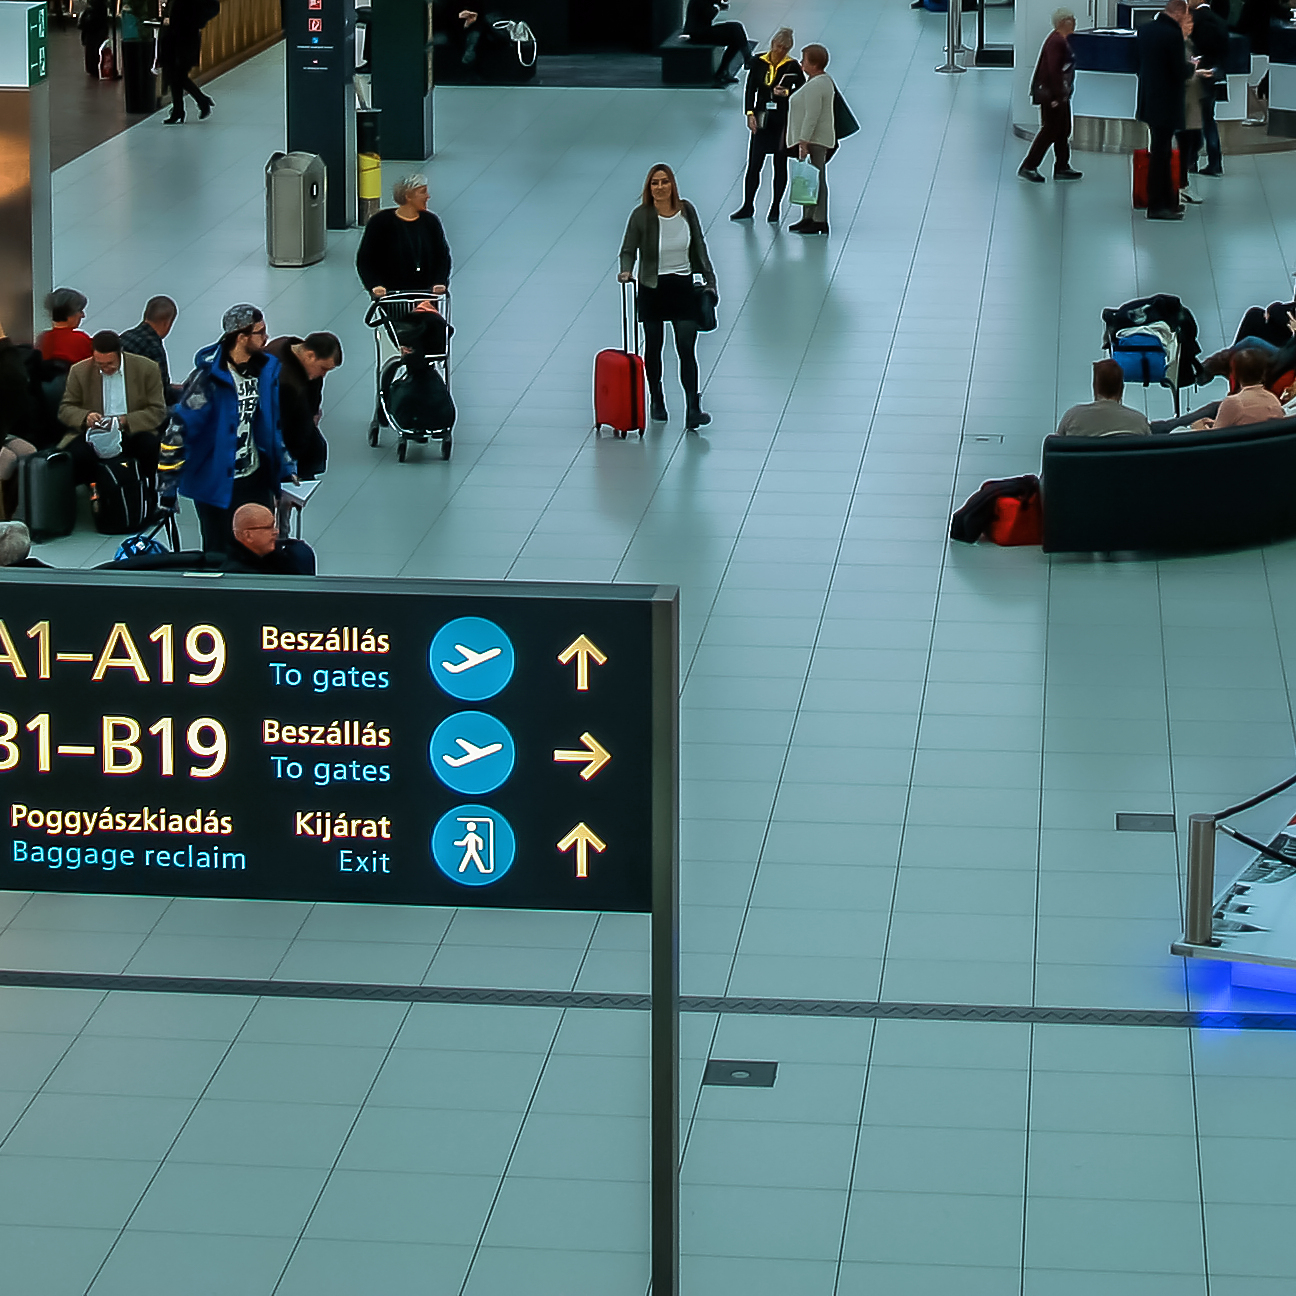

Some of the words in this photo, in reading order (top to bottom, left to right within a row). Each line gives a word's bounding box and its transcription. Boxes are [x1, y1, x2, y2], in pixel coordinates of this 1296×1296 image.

[261, 625, 390, 654] Beszállás
[268, 662, 302, 686] To
[312, 666, 390, 692] gates
[262, 719, 391, 749] Beszállás
[270, 755, 303, 779] To
[313, 760, 391, 786] gates
[10, 803, 233, 836] Poggyászkiadás
[295, 811, 391, 844] Kijárat
[13, 839, 135, 871] Baggage
[145, 844, 246, 870] reclaim
[339, 849, 391, 874] Exit
